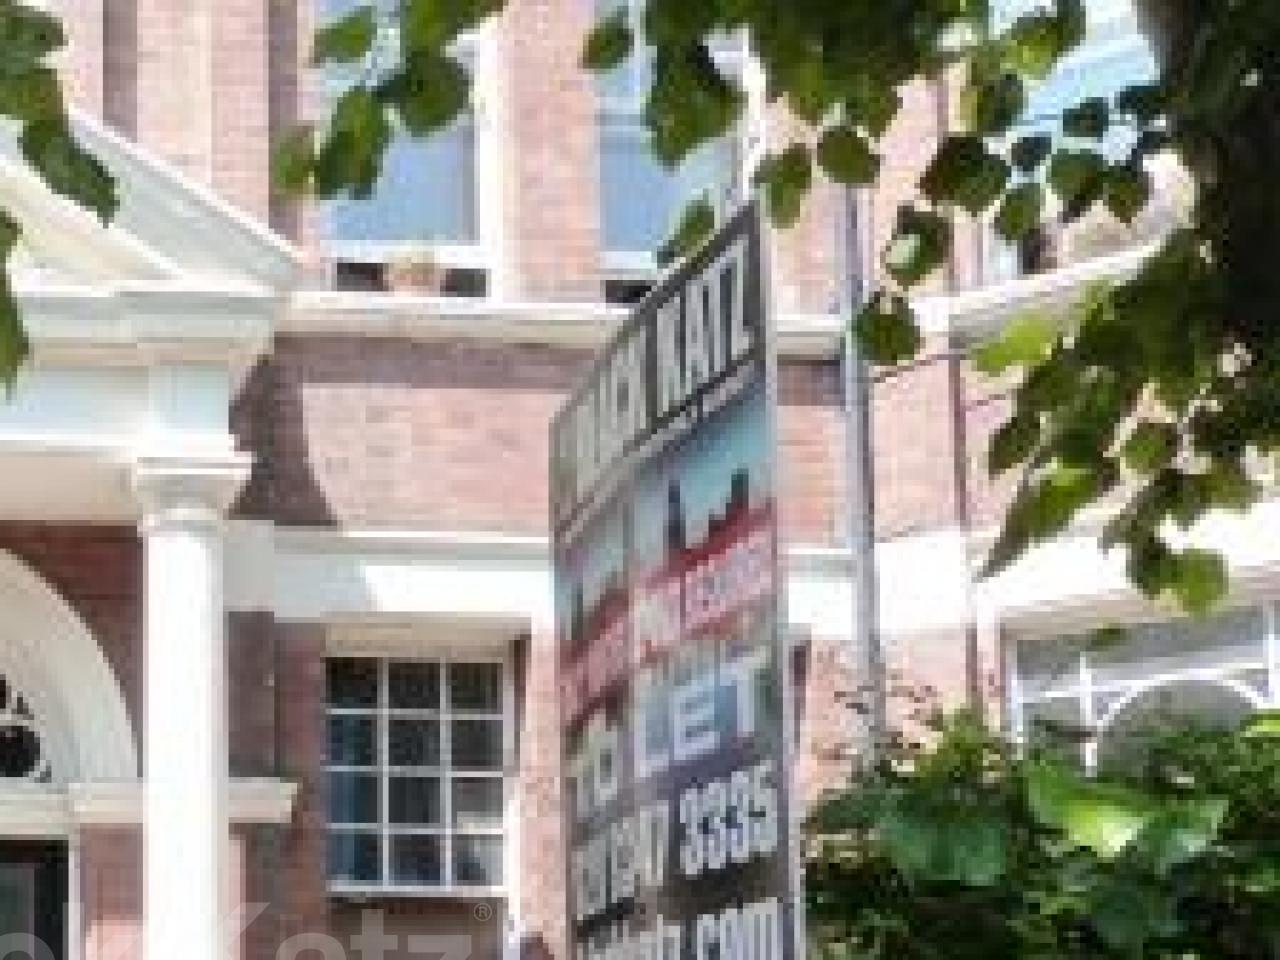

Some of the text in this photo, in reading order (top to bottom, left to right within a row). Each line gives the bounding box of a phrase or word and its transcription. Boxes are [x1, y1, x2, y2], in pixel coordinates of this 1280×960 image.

[656, 234, 754, 418] KATZ
[569, 648, 770, 818] TO LET
[680, 760, 778, 876] 3335
